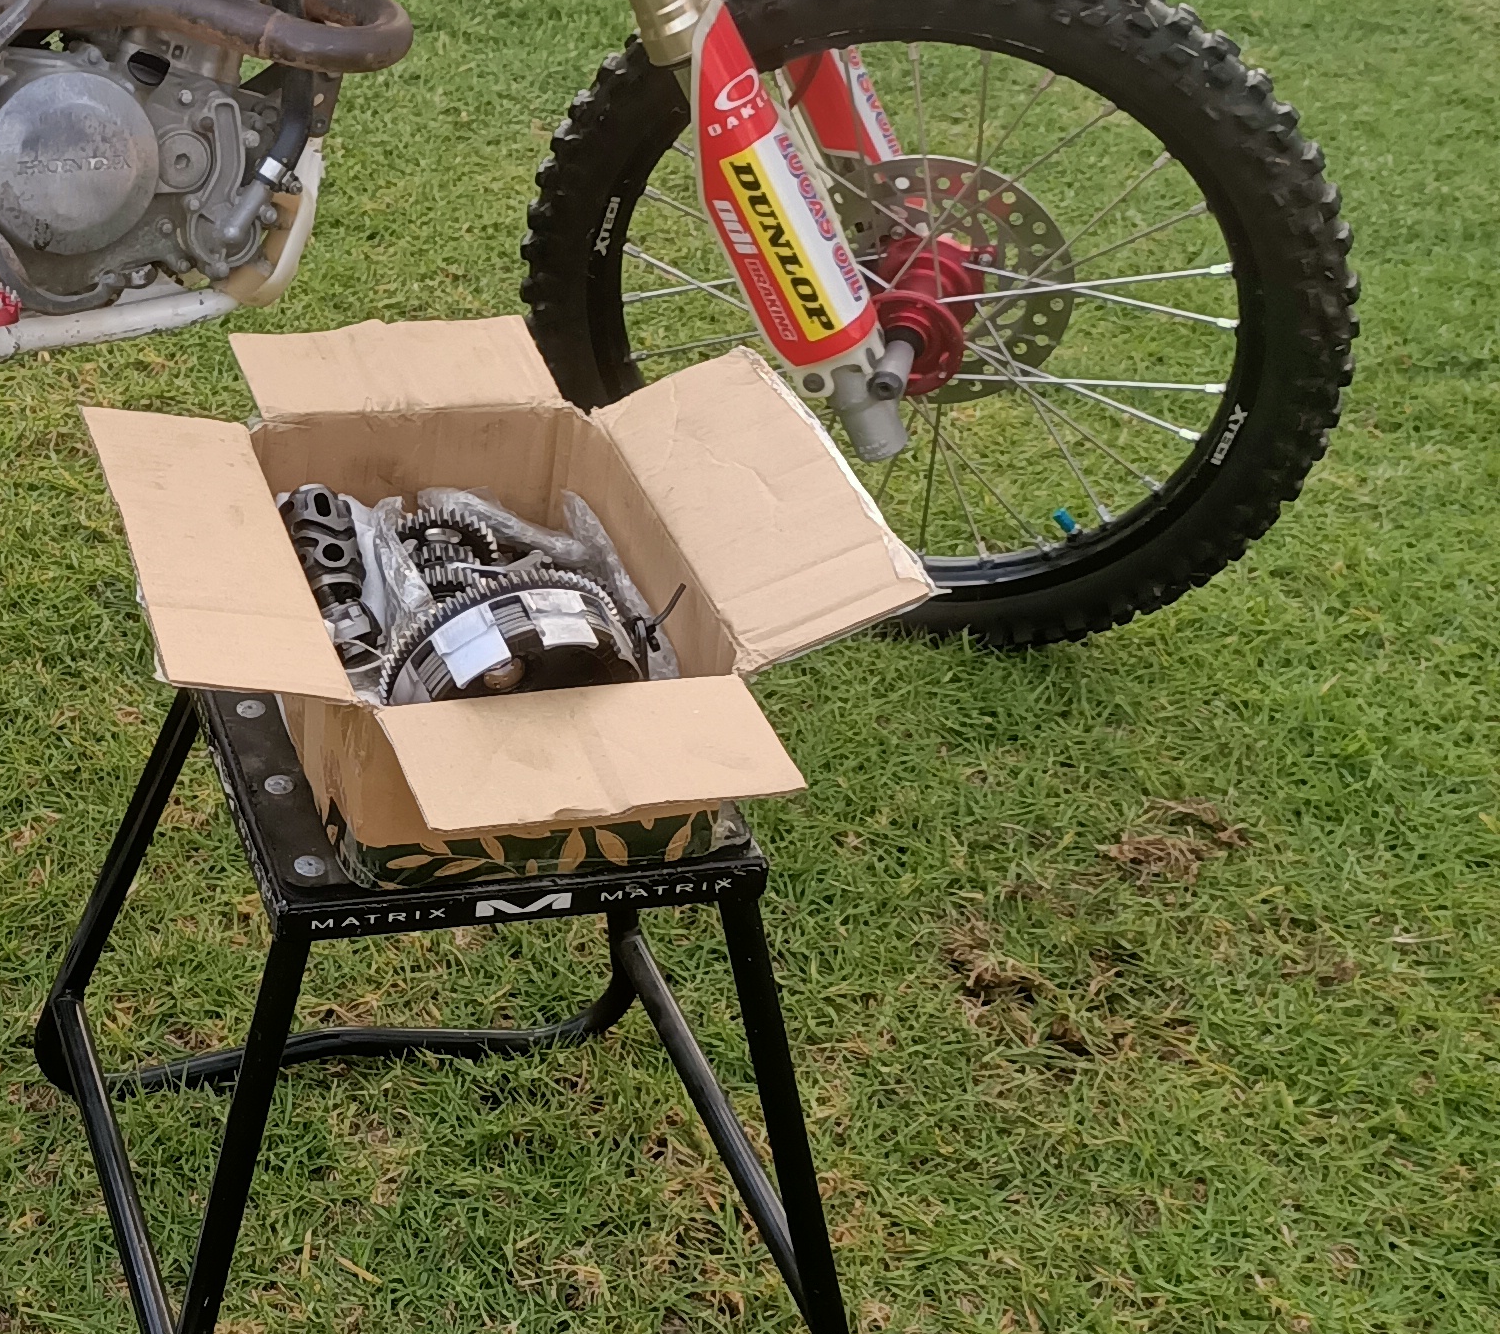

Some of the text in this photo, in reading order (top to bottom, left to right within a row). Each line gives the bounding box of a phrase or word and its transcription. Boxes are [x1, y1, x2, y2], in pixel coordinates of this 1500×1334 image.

[729, 160, 836, 332] DUNLOP
[774, 133, 864, 303] LUCAS OIL
[745, 258, 799, 342] BRAKING
[310, 907, 447, 931] MATRIX
[599, 876, 733, 902] MATRIX
